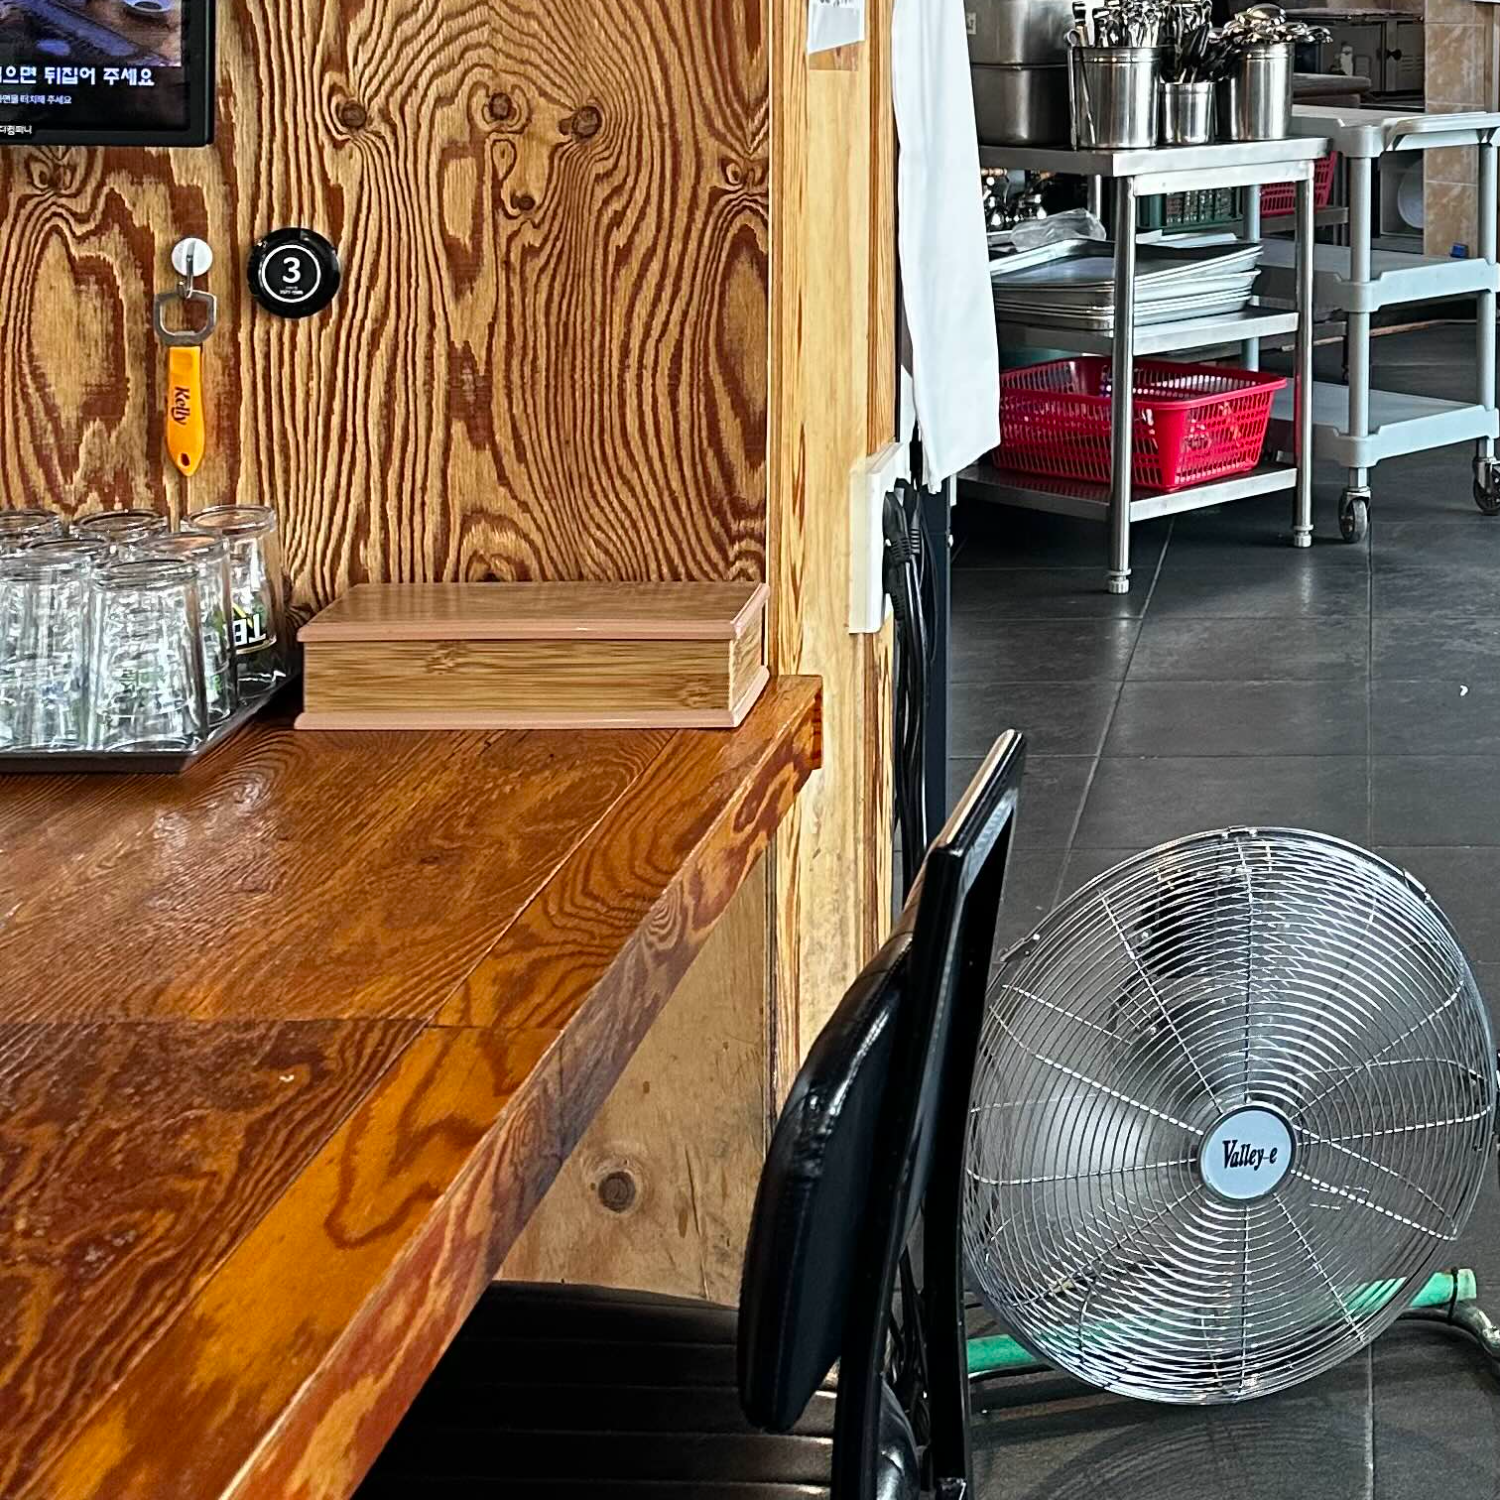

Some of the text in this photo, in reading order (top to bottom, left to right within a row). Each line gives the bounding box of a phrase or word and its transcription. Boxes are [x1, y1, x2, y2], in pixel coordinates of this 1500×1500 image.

[0, 65, 155, 86] 으면 뒤집어 주세요
[282, 257, 301, 283] 3
[170, 386, 191, 426] Kelly
[1222, 1139, 1278, 1171] Valley-e
